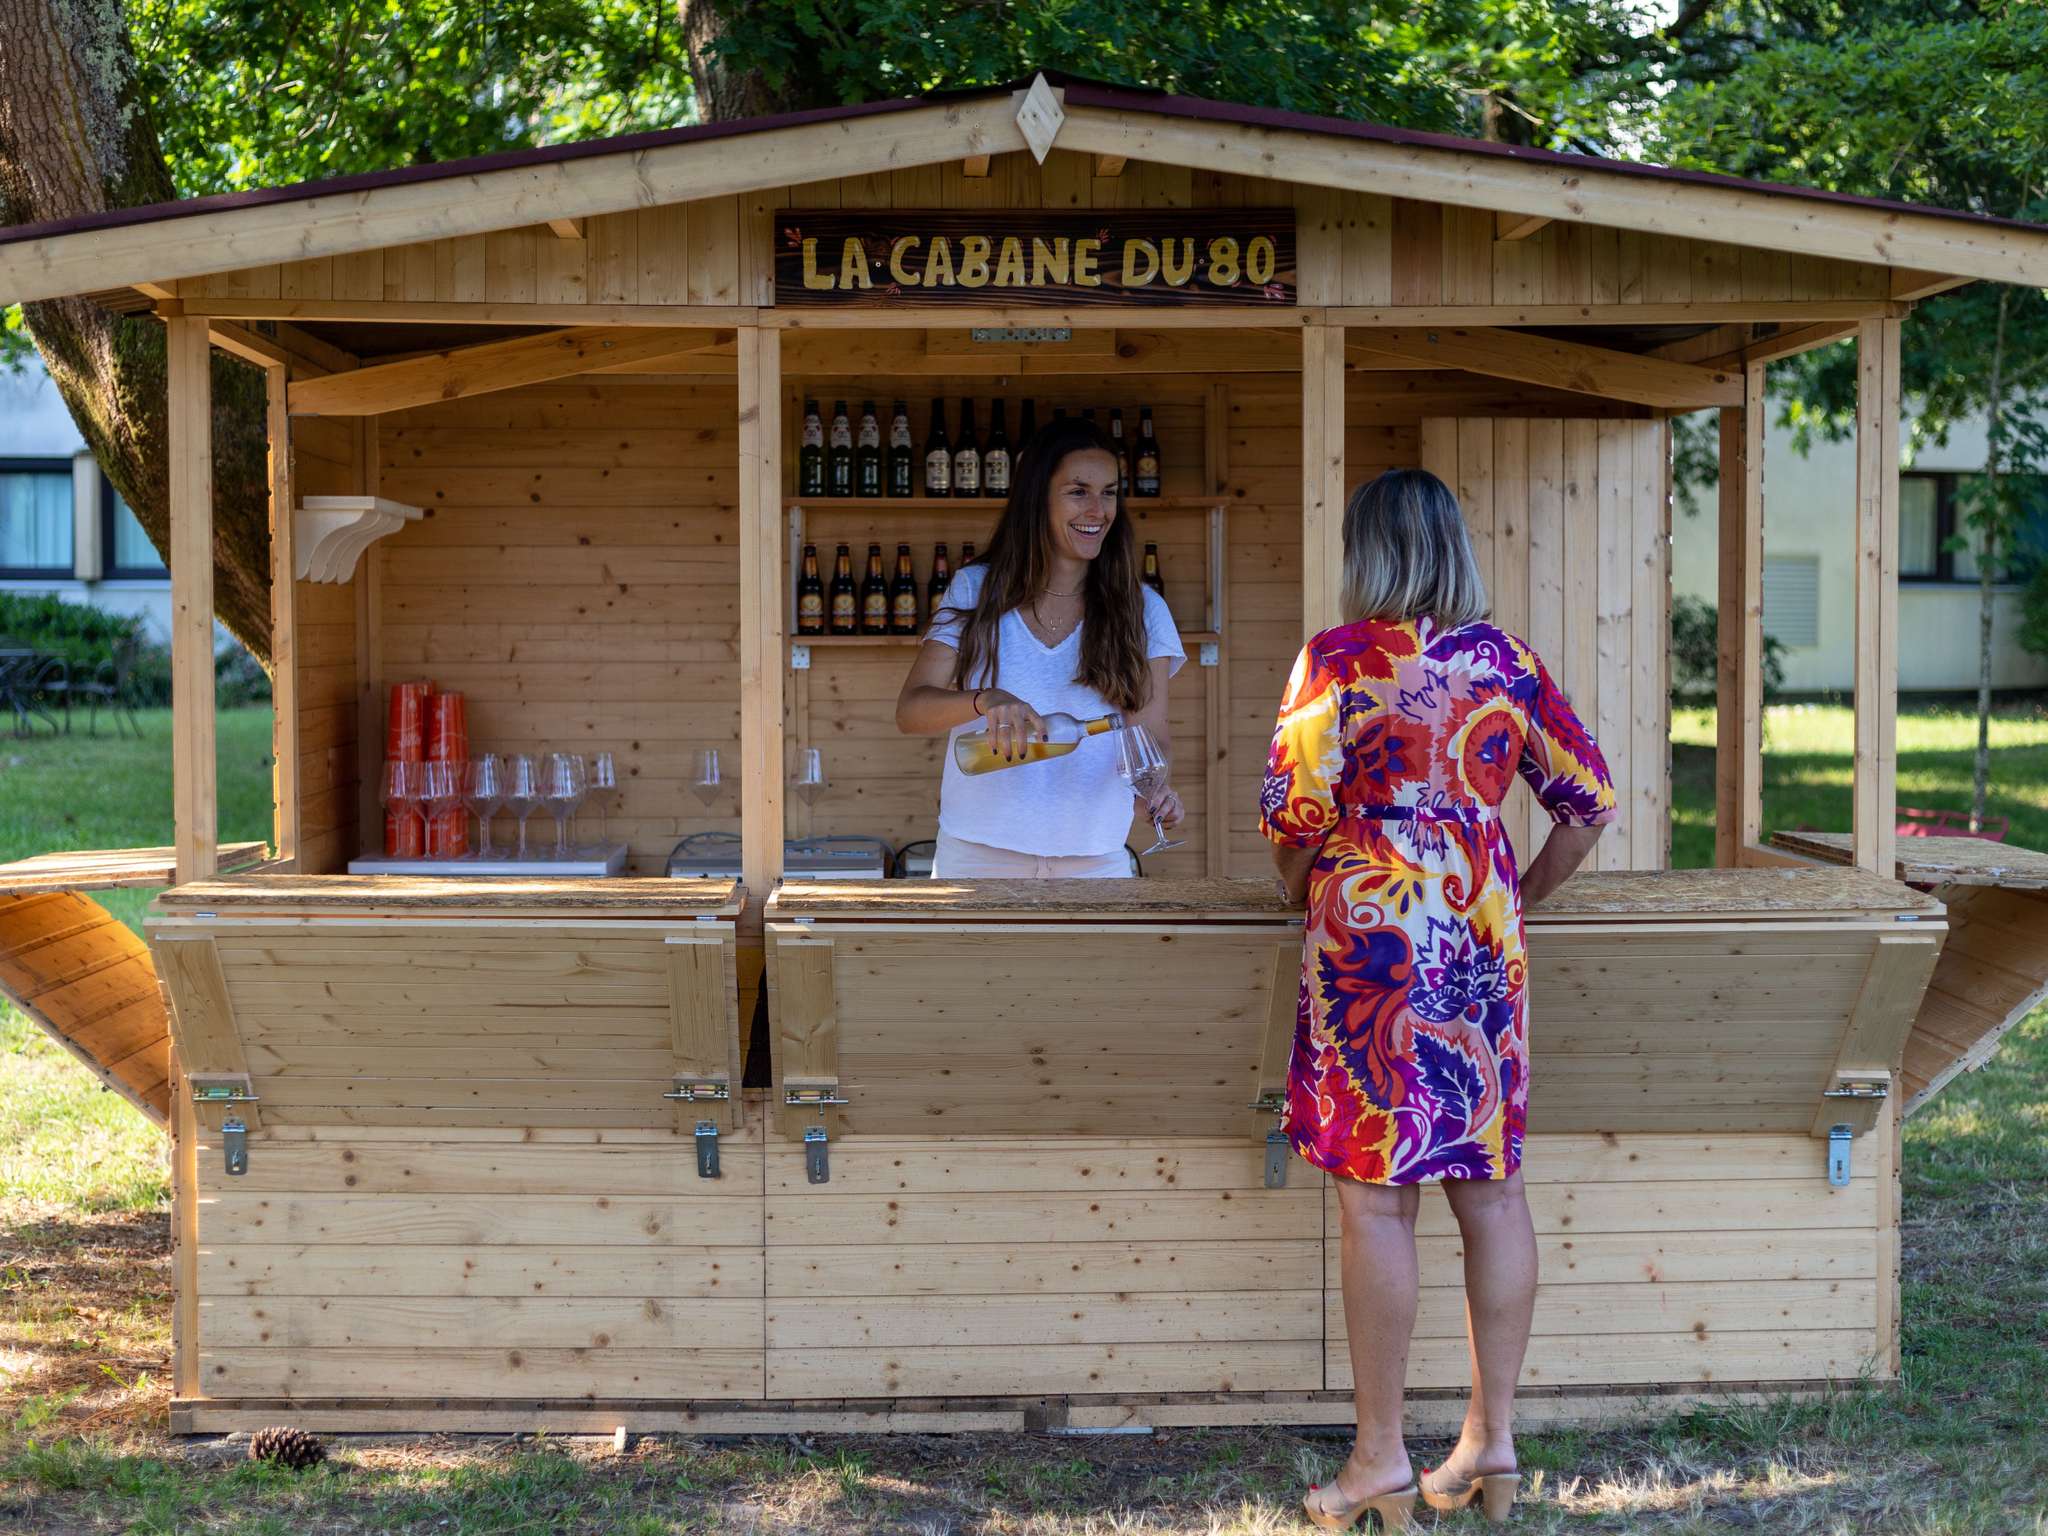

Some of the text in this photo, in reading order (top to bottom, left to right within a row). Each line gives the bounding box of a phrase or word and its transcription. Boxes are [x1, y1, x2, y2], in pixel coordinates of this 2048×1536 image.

[801, 235, 1276, 290] LA CABANE DU 80
